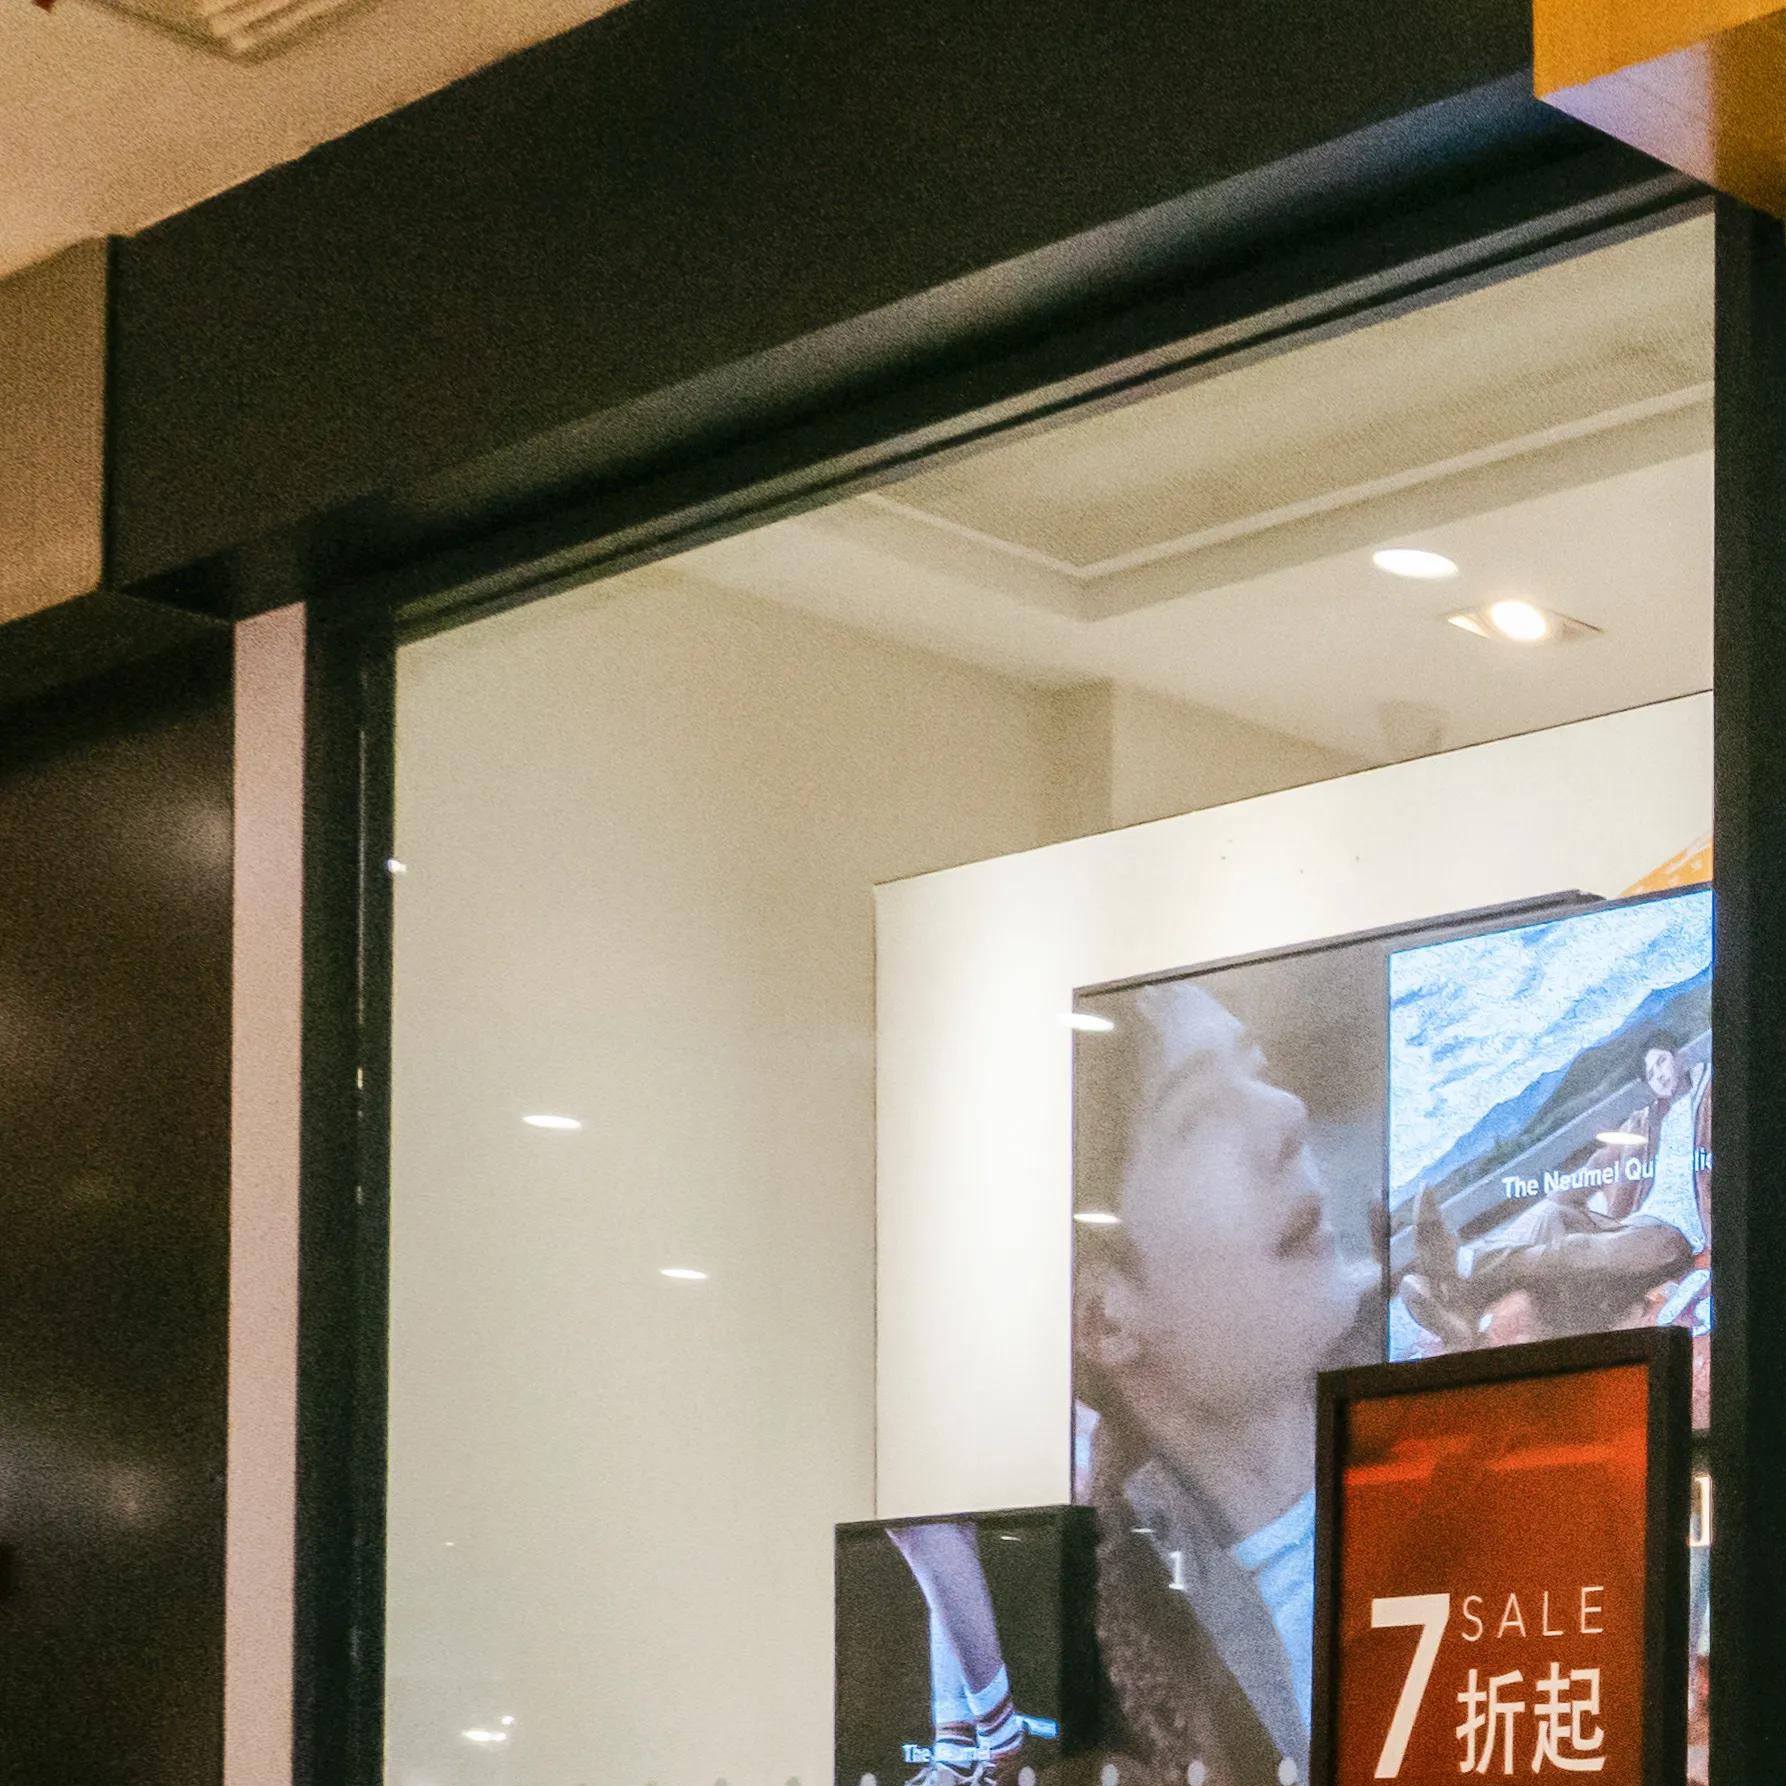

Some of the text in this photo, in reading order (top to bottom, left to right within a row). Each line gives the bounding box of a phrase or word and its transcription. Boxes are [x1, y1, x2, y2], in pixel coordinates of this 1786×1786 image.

[1502, 1175, 1539, 1199] The
[1543, 1160, 1619, 1193] Neumel
[1461, 1585, 1604, 1642] SALE
[1371, 1592, 1450, 1779] 7
[1455, 1662, 1607, 1775] 折起
